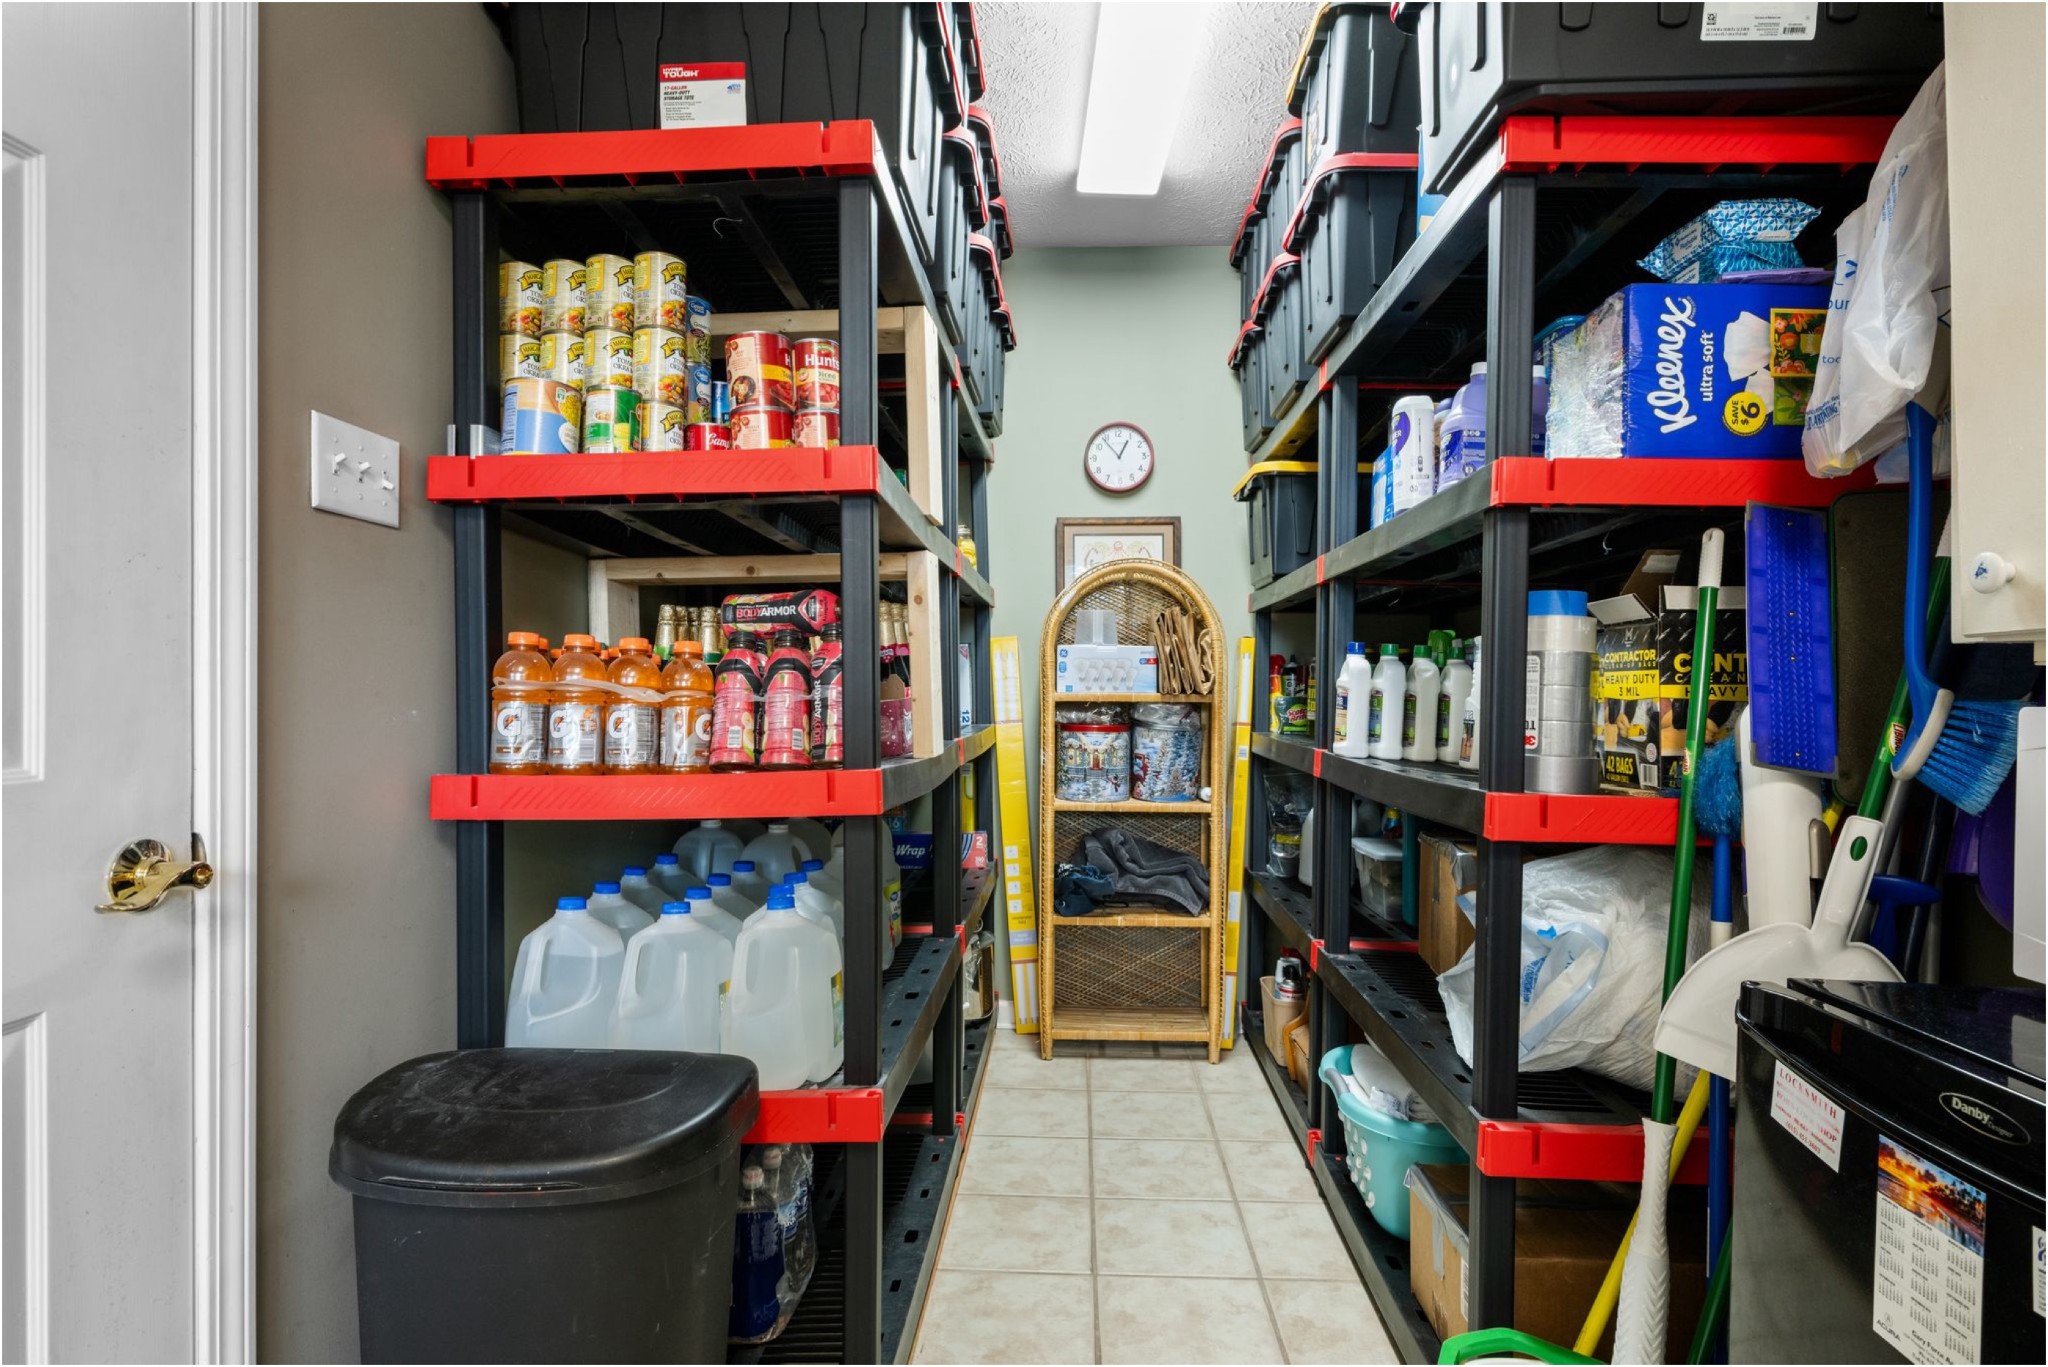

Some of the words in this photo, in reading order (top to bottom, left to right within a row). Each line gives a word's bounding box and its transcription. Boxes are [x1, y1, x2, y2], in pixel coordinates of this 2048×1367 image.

[664, 70, 699, 78] TOUGH
[1699, 331, 1714, 363] soft
[1646, 296, 1698, 434] Kleenex
[1699, 364, 1714, 402] ultra
[1731, 399, 1739, 426] SAVE
[1740, 401, 1760, 426] $6
[736, 604, 798, 618] BODYARMOR
[1604, 649, 1657, 662] CONTRACTOR
[1605, 674, 1631, 685] HEAVY
[1632, 673, 1656, 685] DUTY
[1619, 686, 1624, 697] 3
[1625, 685, 1640, 697] MIL
[1606, 755, 1615, 771] 42
[1615, 757, 1634, 776] BAGS
[895, 843, 926, 859] Wrap
[975, 836, 984, 848] 2
[1779, 1067, 1837, 1120] LOCKSMITH
[1951, 1096, 1990, 1125] Danby
[1876, 1318, 1901, 1342] ACURA
